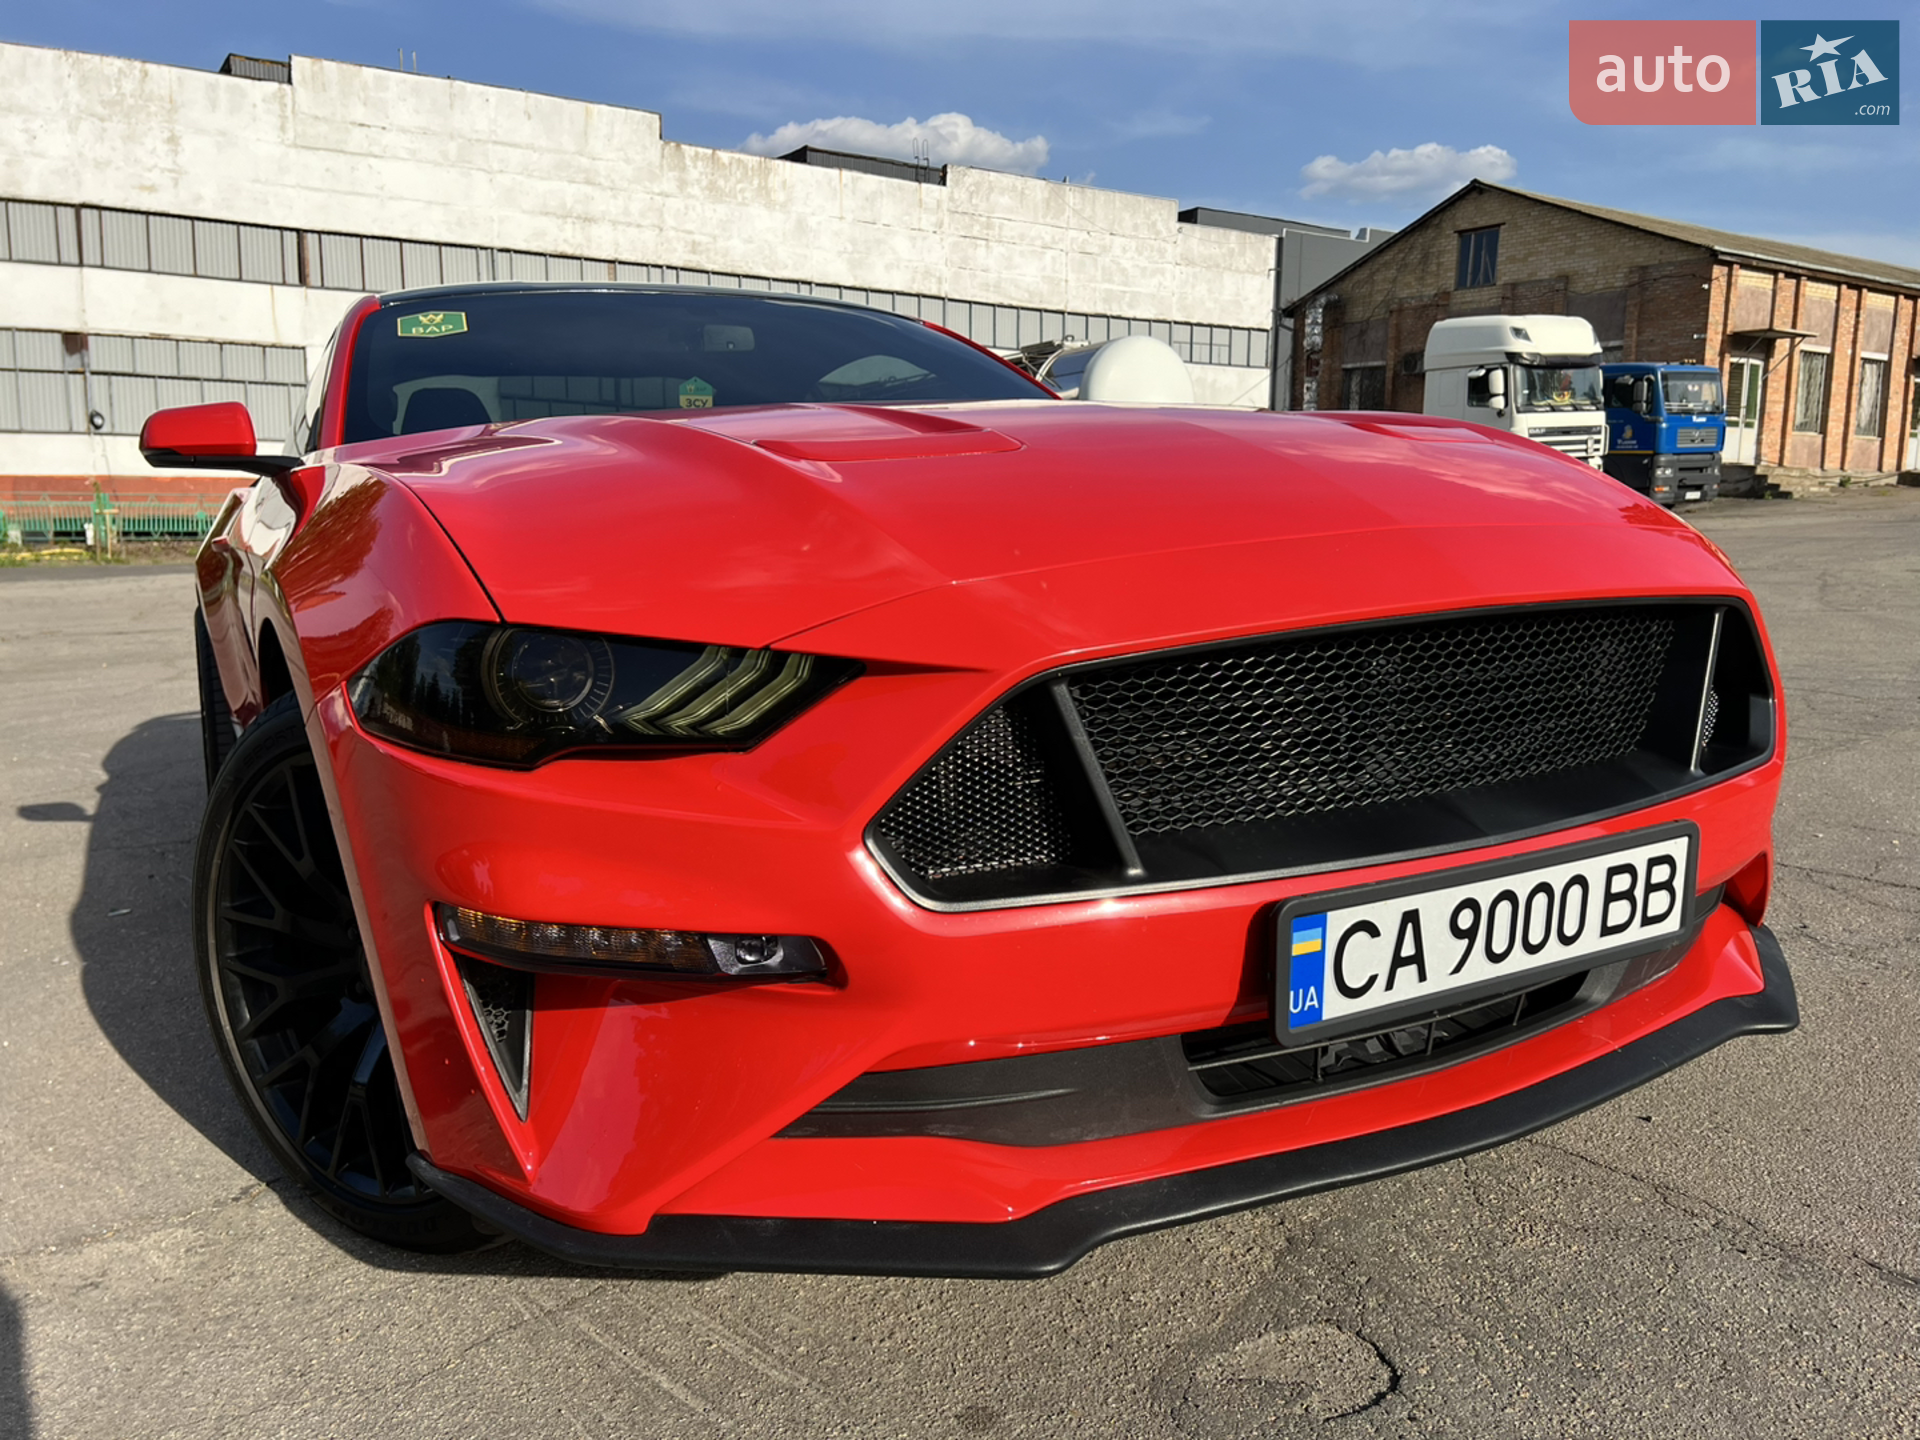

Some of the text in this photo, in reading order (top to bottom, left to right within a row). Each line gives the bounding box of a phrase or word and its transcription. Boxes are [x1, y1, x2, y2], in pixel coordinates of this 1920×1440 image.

[1333, 854, 1677, 999] CA 9000 BB
[1289, 986, 1319, 1014] UA
